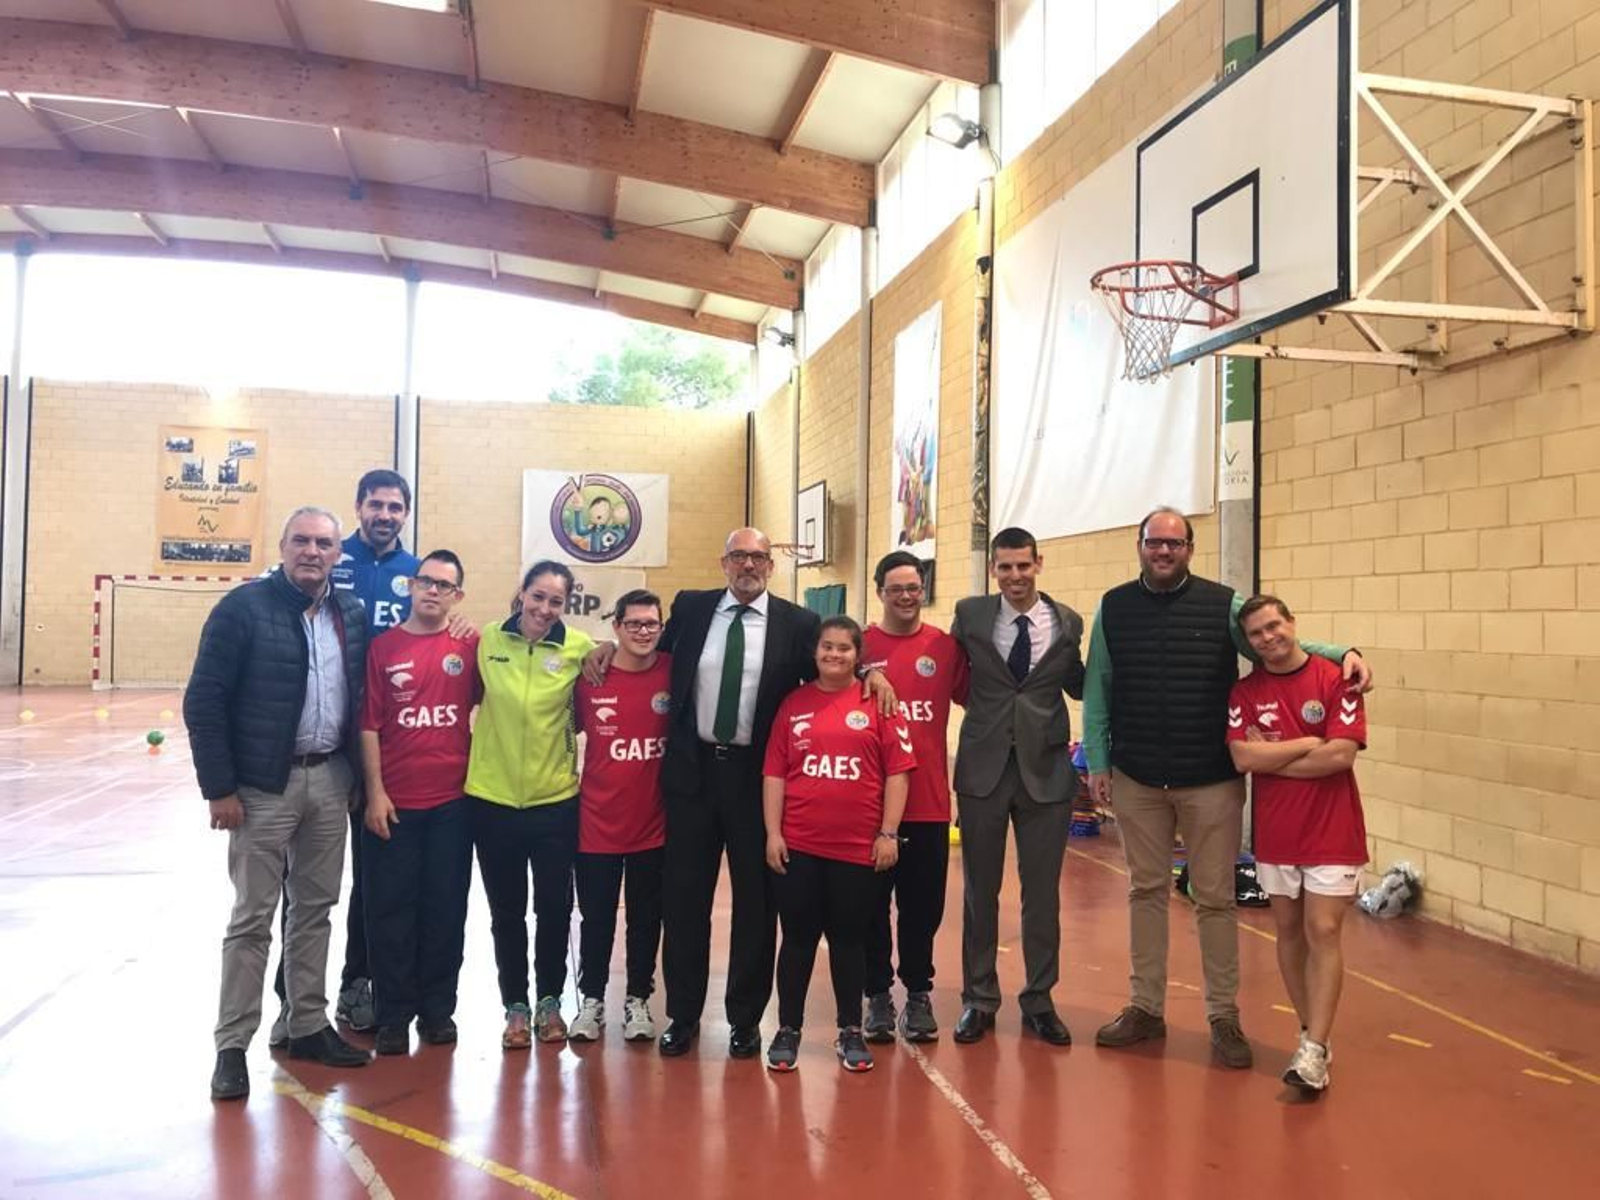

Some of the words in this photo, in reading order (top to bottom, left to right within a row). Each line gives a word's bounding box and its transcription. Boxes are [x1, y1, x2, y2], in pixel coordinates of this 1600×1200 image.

[398, 704, 458, 729] GAES
[610, 737, 668, 761] GAES
[802, 754, 861, 780] GAES
